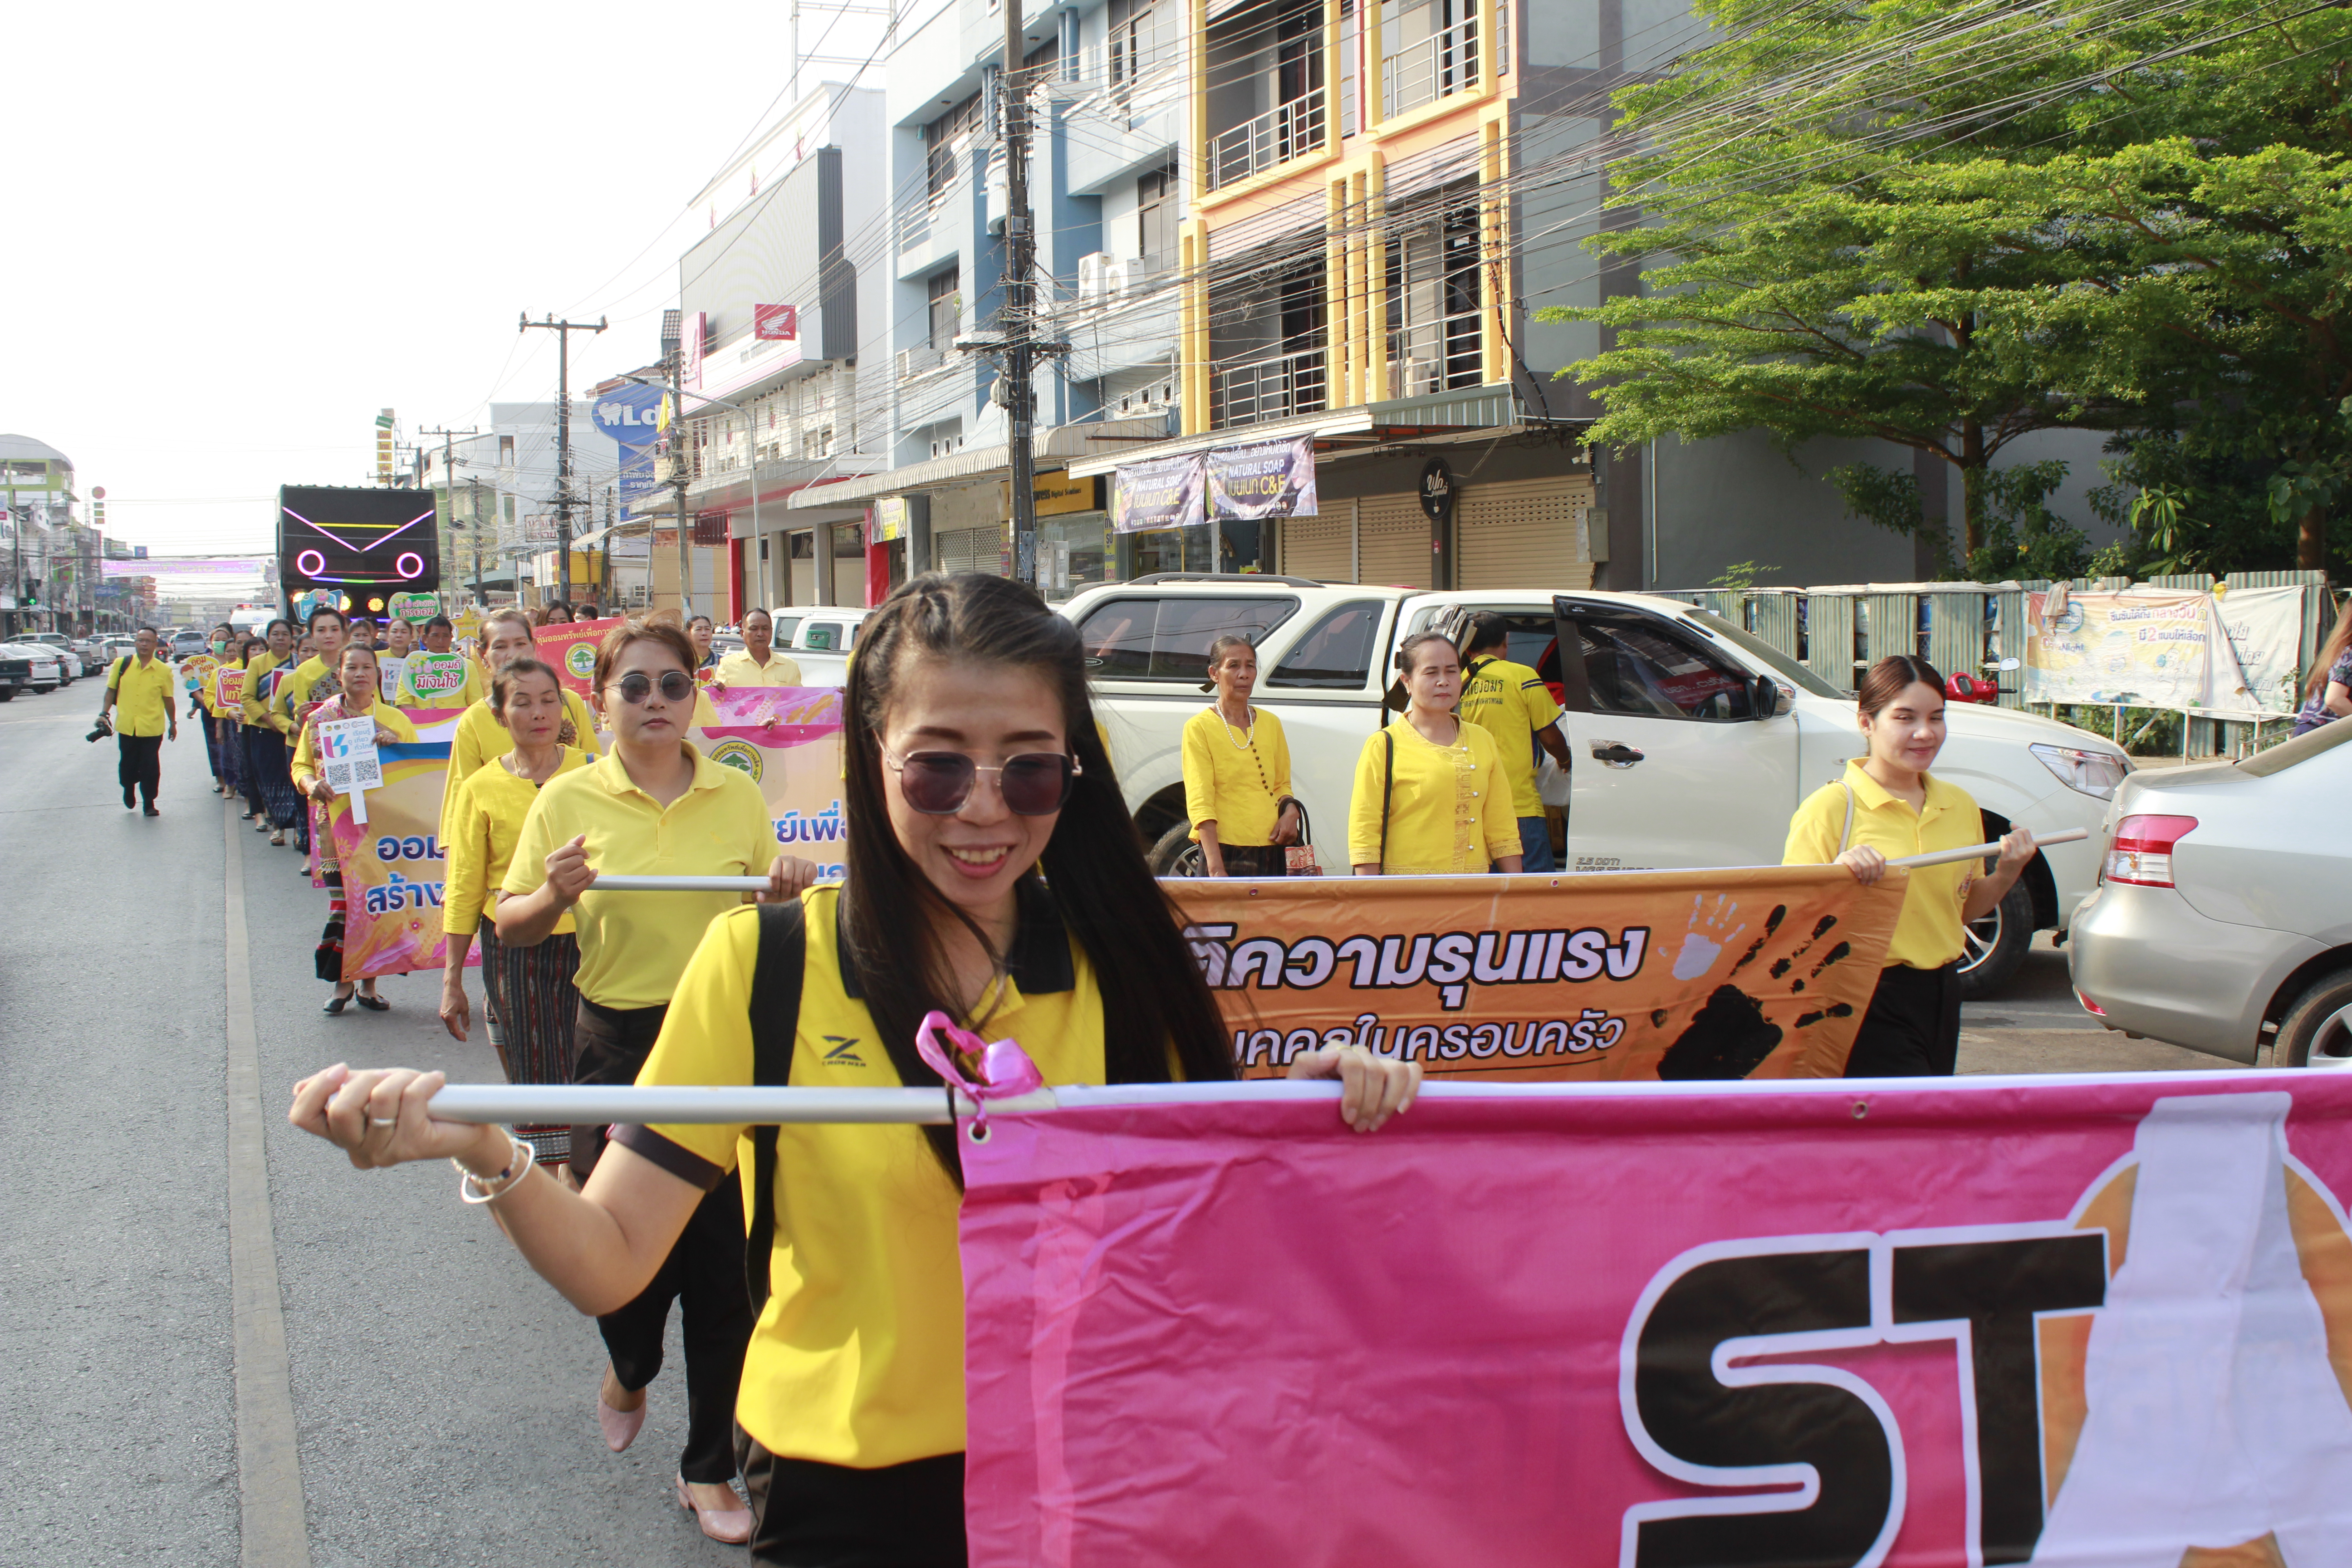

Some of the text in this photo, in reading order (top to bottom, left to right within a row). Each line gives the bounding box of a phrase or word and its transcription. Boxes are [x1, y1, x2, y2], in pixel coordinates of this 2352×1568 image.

[1229, 459, 1285, 478] NATURAL SOAP
[1136, 474, 1182, 492] NATURAL SOAP
[1260, 474, 1286, 495] C&E
[1033, 487, 1081, 501] press Digital Solutions
[1160, 487, 1181, 506] C&E
[400, 608, 435, 617] การออม
[2152, 604, 2196, 619] กลางวัน
[537, 626, 615, 646] ลุ่มออมทรัพย์เพื่อการ
[191, 656, 206, 666] ออม
[199, 664, 214, 674] ก่อน
[434, 659, 461, 670] ออมดี
[416, 671, 460, 689] มีเงินใช้
[771, 801, 847, 843] ย์เพื่
[1576, 857, 1594, 865] 2.5
[367, 873, 444, 913] สร้าง
